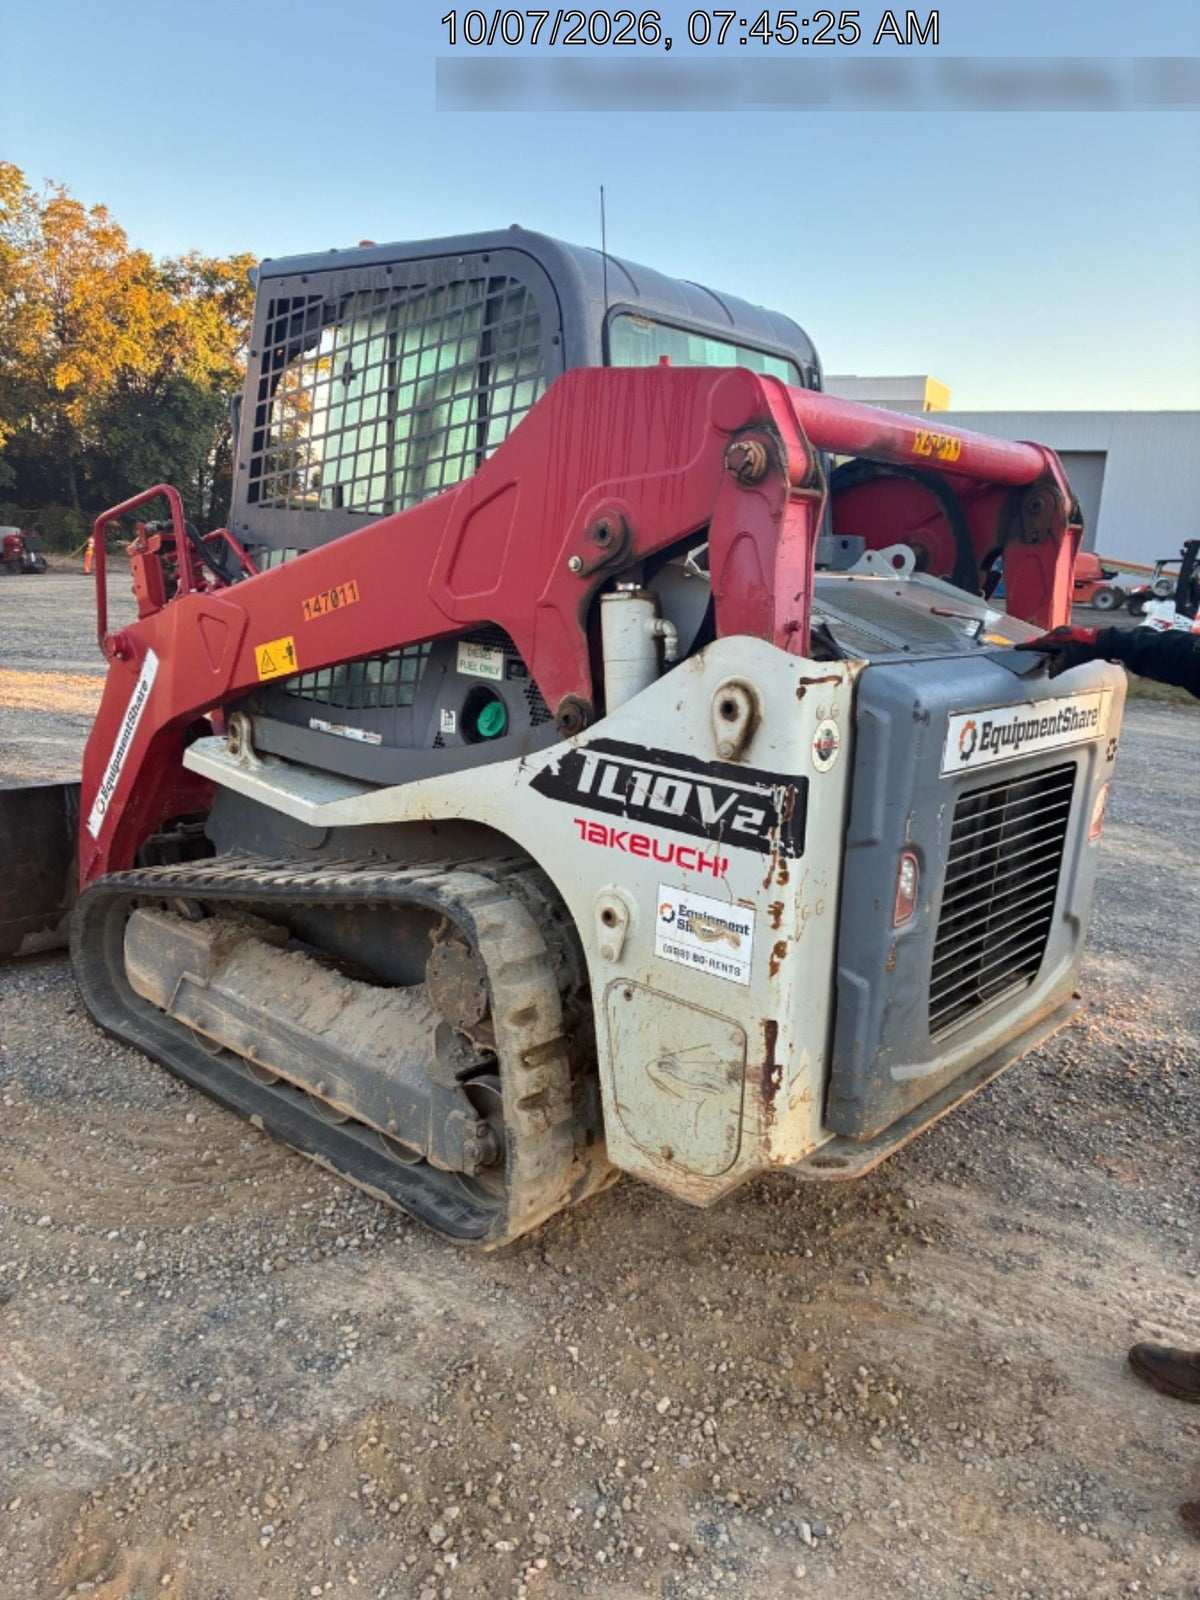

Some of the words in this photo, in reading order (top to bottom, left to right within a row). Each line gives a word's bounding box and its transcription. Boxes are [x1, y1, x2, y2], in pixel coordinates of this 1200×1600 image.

[304, 581, 357, 618] 147011
[460, 659, 478, 672] FUEL
[480, 663, 500, 675] ONLY
[100, 680, 149, 798] EquipmentShare
[979, 706, 1099, 754] EquipmentShare
